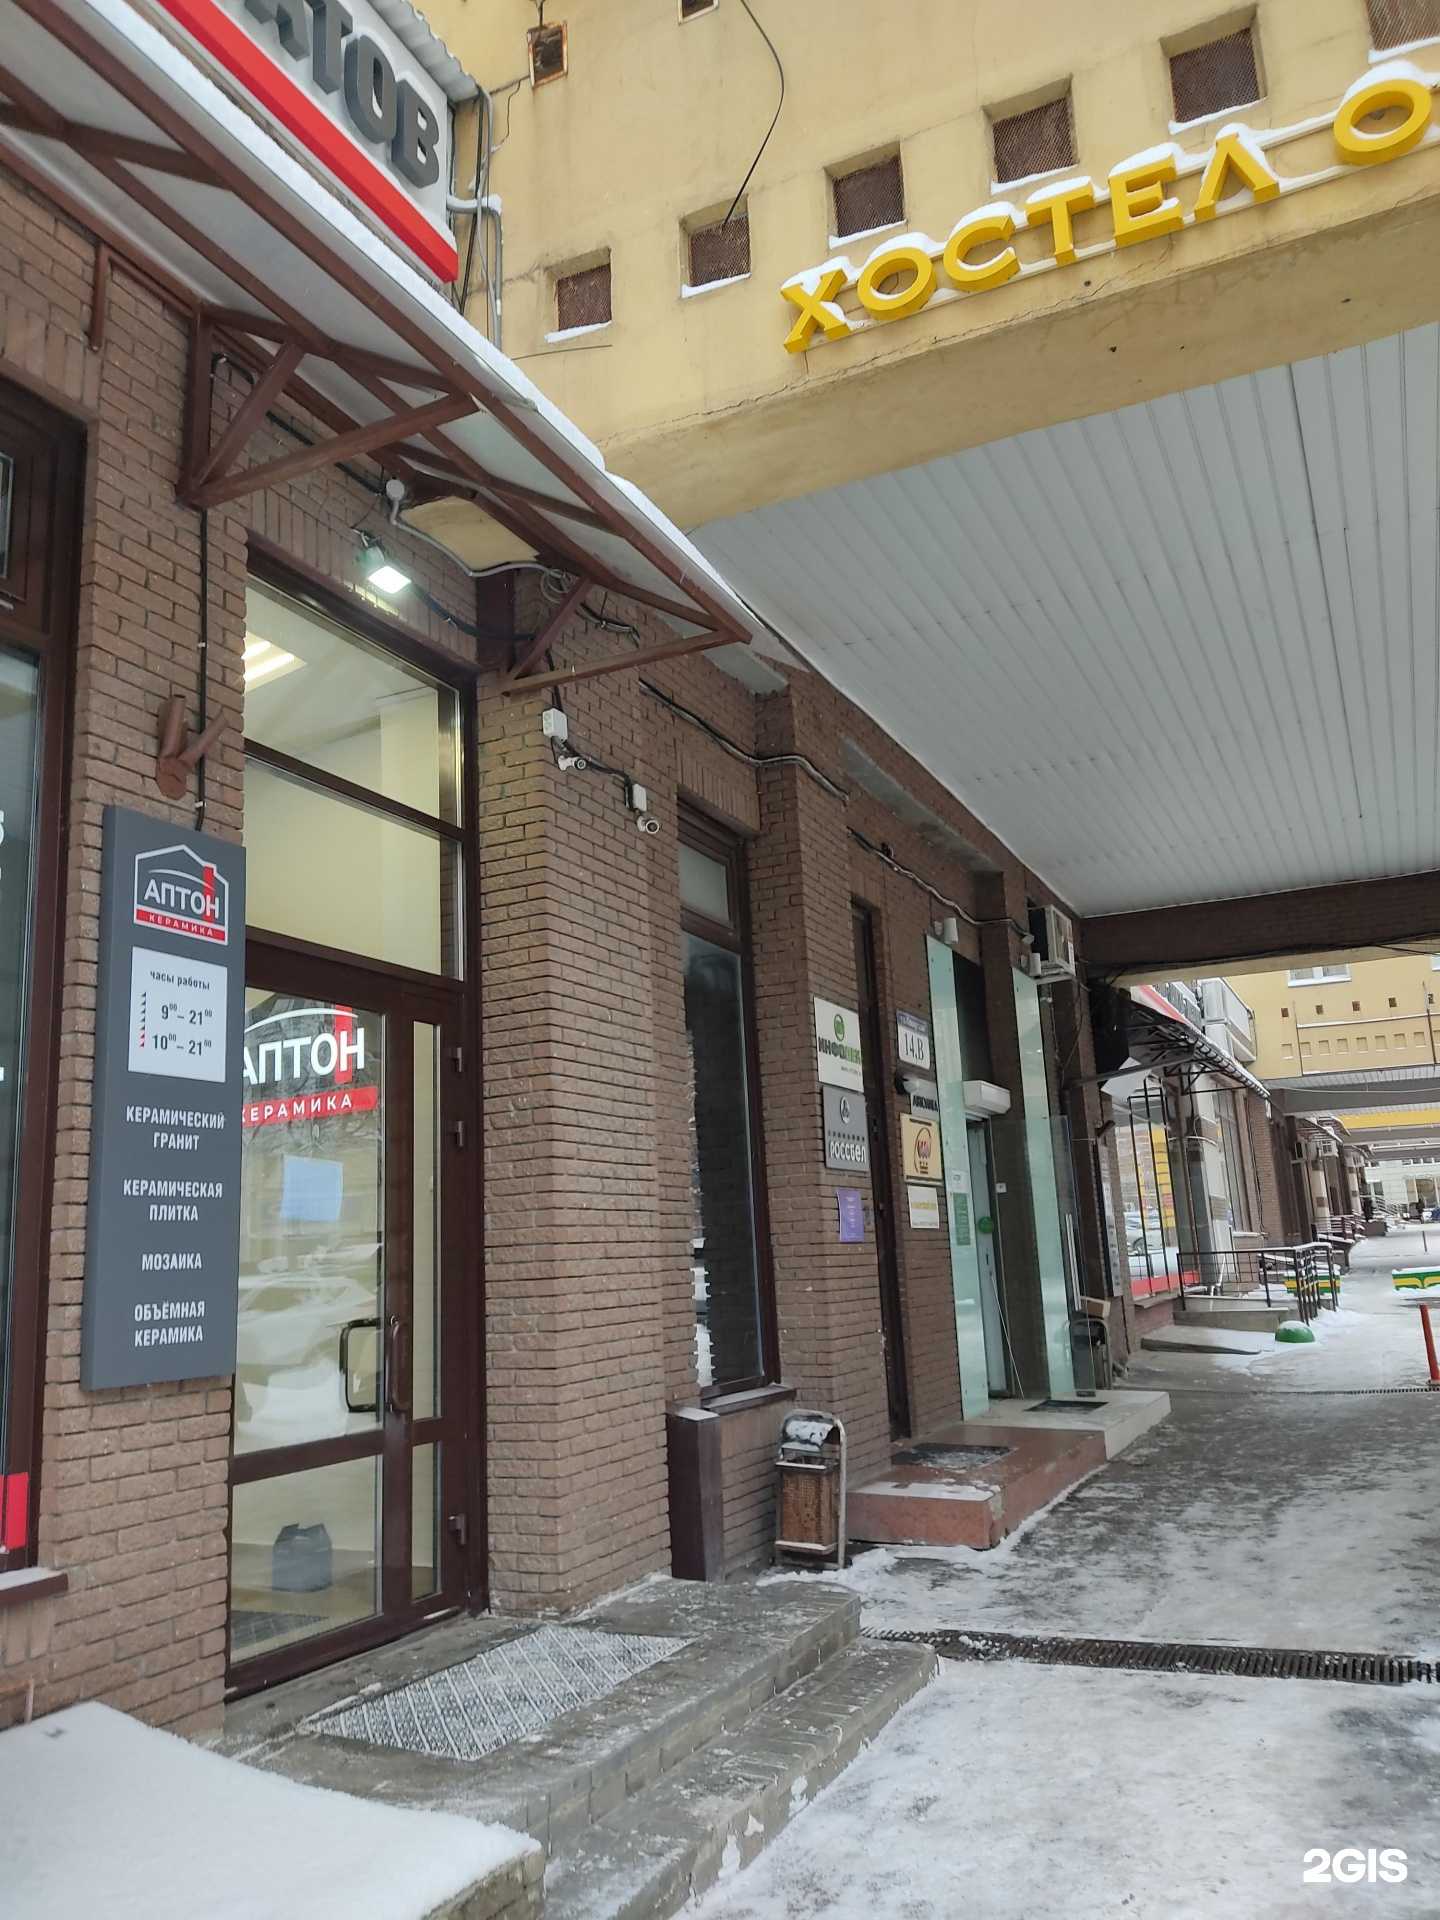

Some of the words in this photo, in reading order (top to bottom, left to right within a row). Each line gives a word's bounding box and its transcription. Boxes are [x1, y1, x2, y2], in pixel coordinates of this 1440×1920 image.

[781, 132, 1280, 353] ХОСТЕЛ
[143, 878, 220, 919] АПТОН
[149, 914, 213, 936] КЕРАМИКА
[150, 970, 174, 983] часы
[177, 976, 210, 990] работы
[126, 1105, 225, 1129] КЕРАМИЧЕСКИЙ
[241, 1094, 353, 1122] ЕРАМИКА
[153, 1132, 200, 1151] ГРАНИТ
[123, 1179, 223, 1198] КЕРАМИЧЕСКАЯ
[149, 1204, 199, 1221] ПЛИТКА
[141, 1253, 203, 1271] МОЗАИКА
[134, 1325, 204, 1347] КЕРАМИКА
